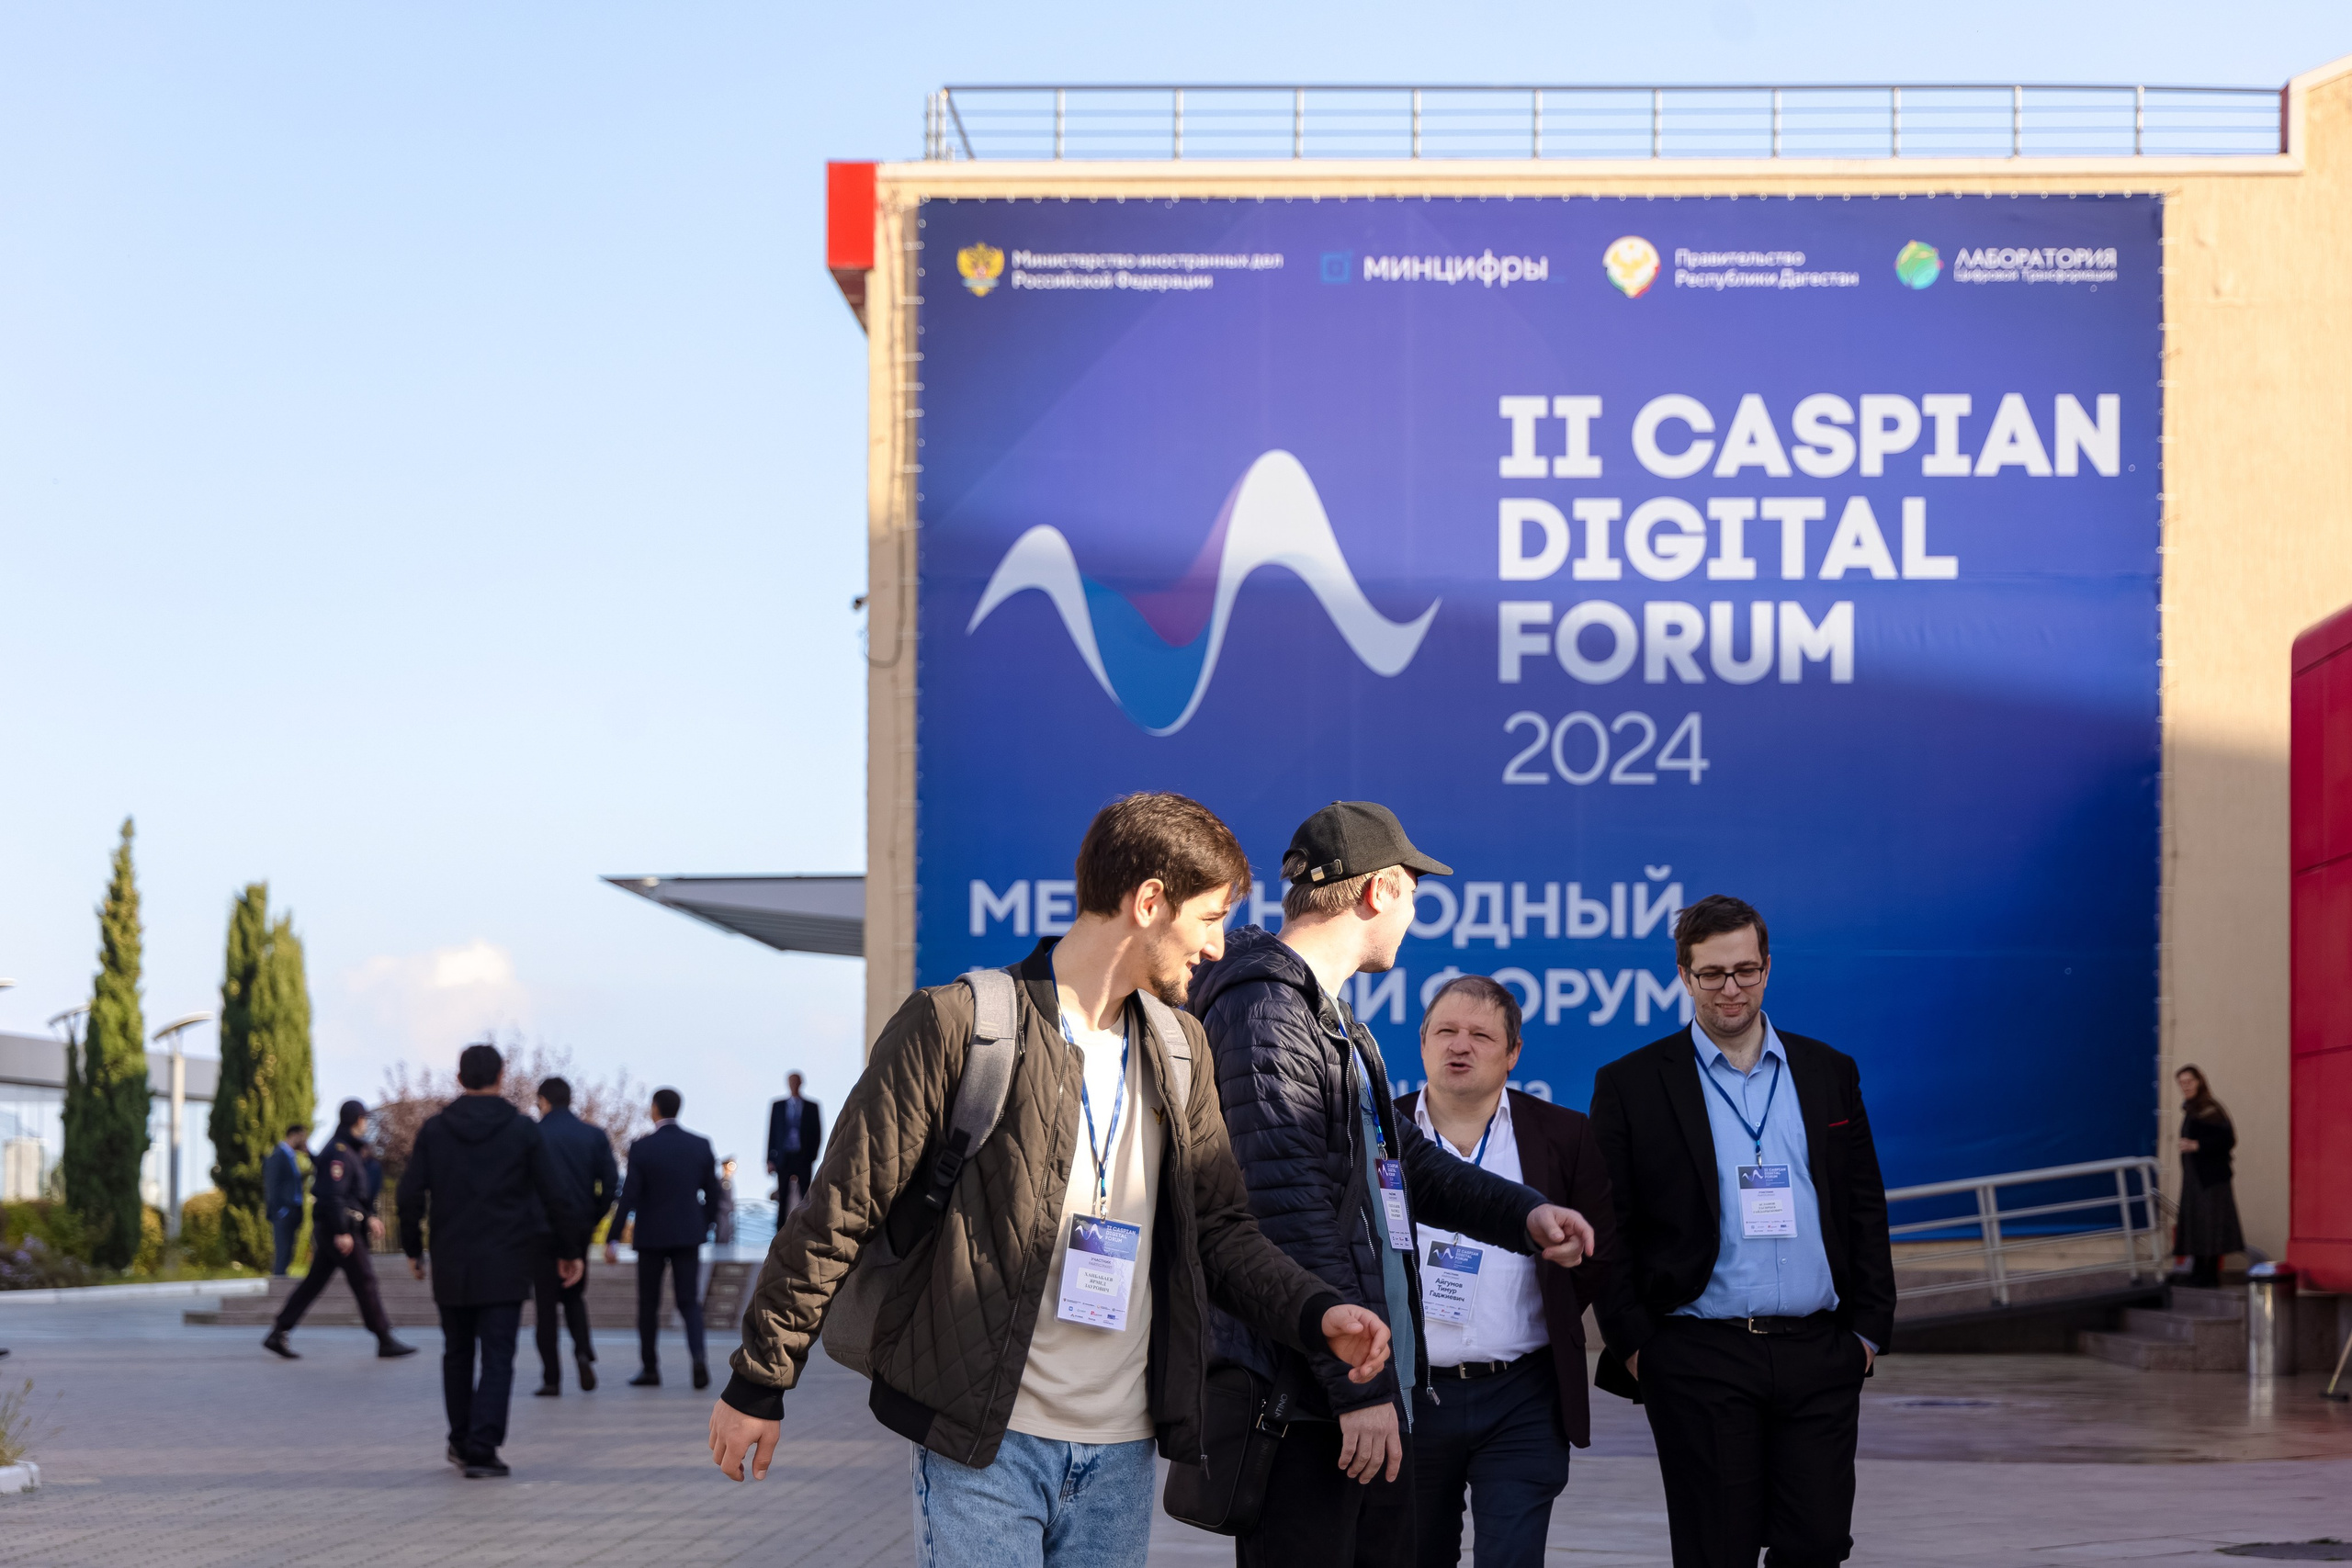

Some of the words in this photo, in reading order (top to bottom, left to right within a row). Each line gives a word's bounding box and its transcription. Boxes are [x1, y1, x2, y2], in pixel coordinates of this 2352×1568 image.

[1012, 249, 1137, 272] Министерство
[1138, 252, 1250, 273] иностранных
[1250, 253, 1284, 271] дел
[1675, 248, 1806, 270] Правительство
[1953, 247, 2118, 269] ЛАБОРАТОРИЯ
[1012, 270, 1114, 290] Российской
[1114, 270, 1214, 292] Федерации
[1675, 268, 1778, 291] Республики
[1777, 267, 1860, 290] Дагестан
[1498, 395, 1603, 479] II
[1631, 392, 2121, 479] CASPIAN
[1498, 496, 1959, 581] DIGITAL
[1498, 600, 1855, 685] FORUM
[1501, 710, 1710, 786] 2024
[1104, 1235, 1123, 1244] FORUM
[1105, 1231, 1127, 1239] DIGITAL
[1113, 1225, 1136, 1235] CASPIAN
[1435, 1278, 1464, 1289] Айгумов
[1437, 1284, 1457, 1295] Тимур
[1430, 1290, 1465, 1303] Гаджиевич
